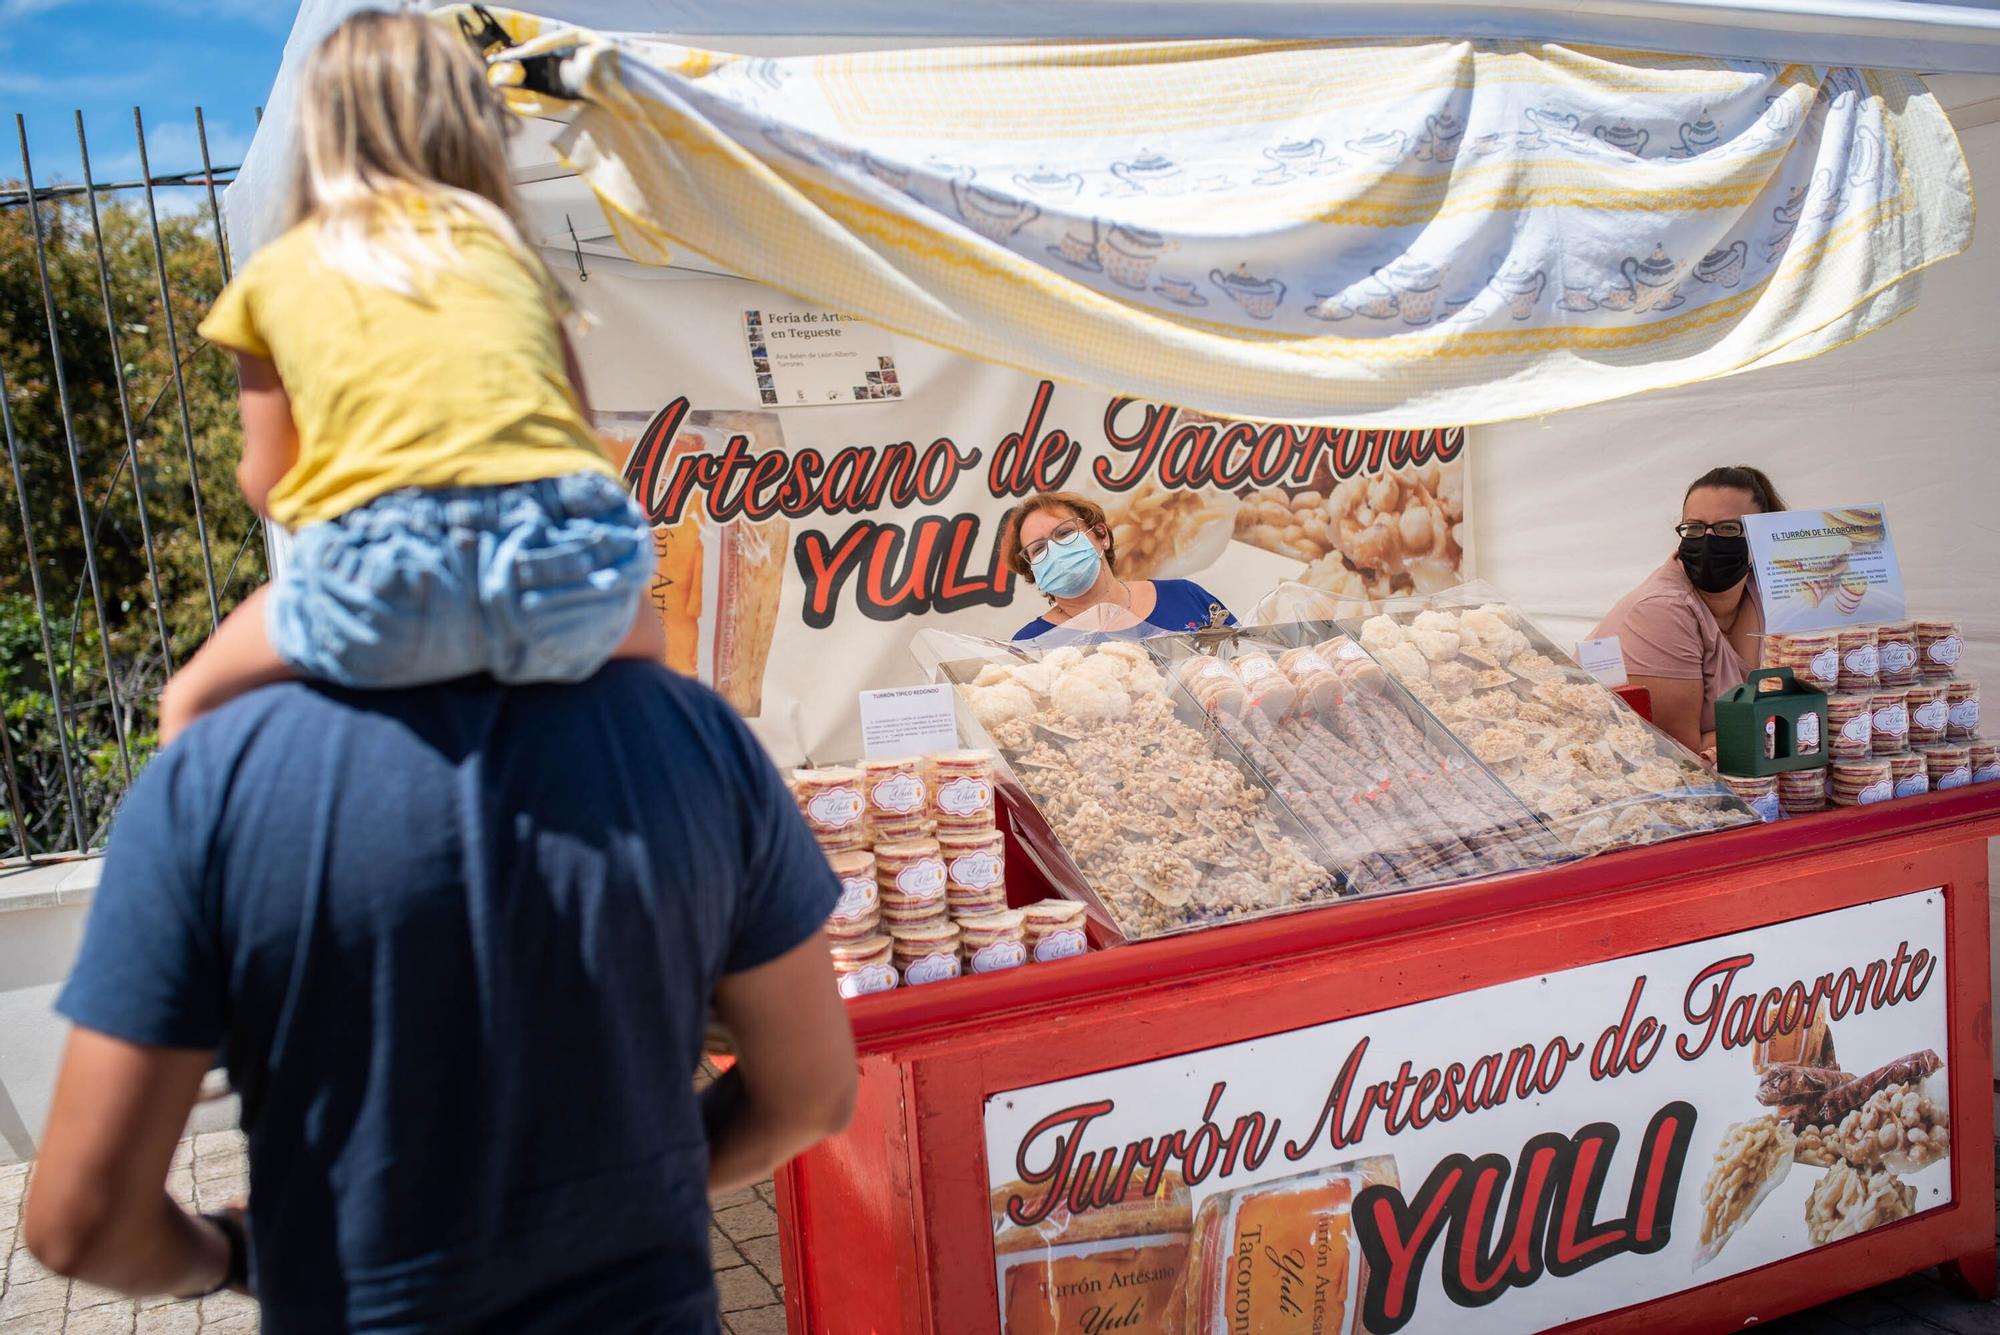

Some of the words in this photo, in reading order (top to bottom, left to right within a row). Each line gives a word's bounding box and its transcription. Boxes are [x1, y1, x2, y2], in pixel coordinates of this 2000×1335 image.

[769, 312, 800, 323] Feria
[803, 312, 818, 323] de
[821, 312, 862, 323] Artes
[771, 331, 786, 339] en
[788, 328, 841, 340] Tegueste
[624, 396, 982, 524] Artesano
[988, 380, 1080, 498] de
[1771, 532, 1780, 540] EL
[1781, 528, 1811, 539] TURRÓN
[1812, 527, 1822, 536] DE
[1823, 524, 1865, 535] TACORONTE
[794, 508, 1016, 629] YULI
[1007, 1081, 1281, 1227] Turrón
[1284, 1036, 1584, 1161] Artesano
[1589, 975, 1666, 1081] de
[1675, 941, 1936, 1061] Tacoronte
[1351, 1101, 1697, 1335] YULI
[1109, 1266, 1175, 1290] Artesano
[1264, 1244, 1305, 1318] Yuli
[1079, 1296, 1144, 1335] Yuli
